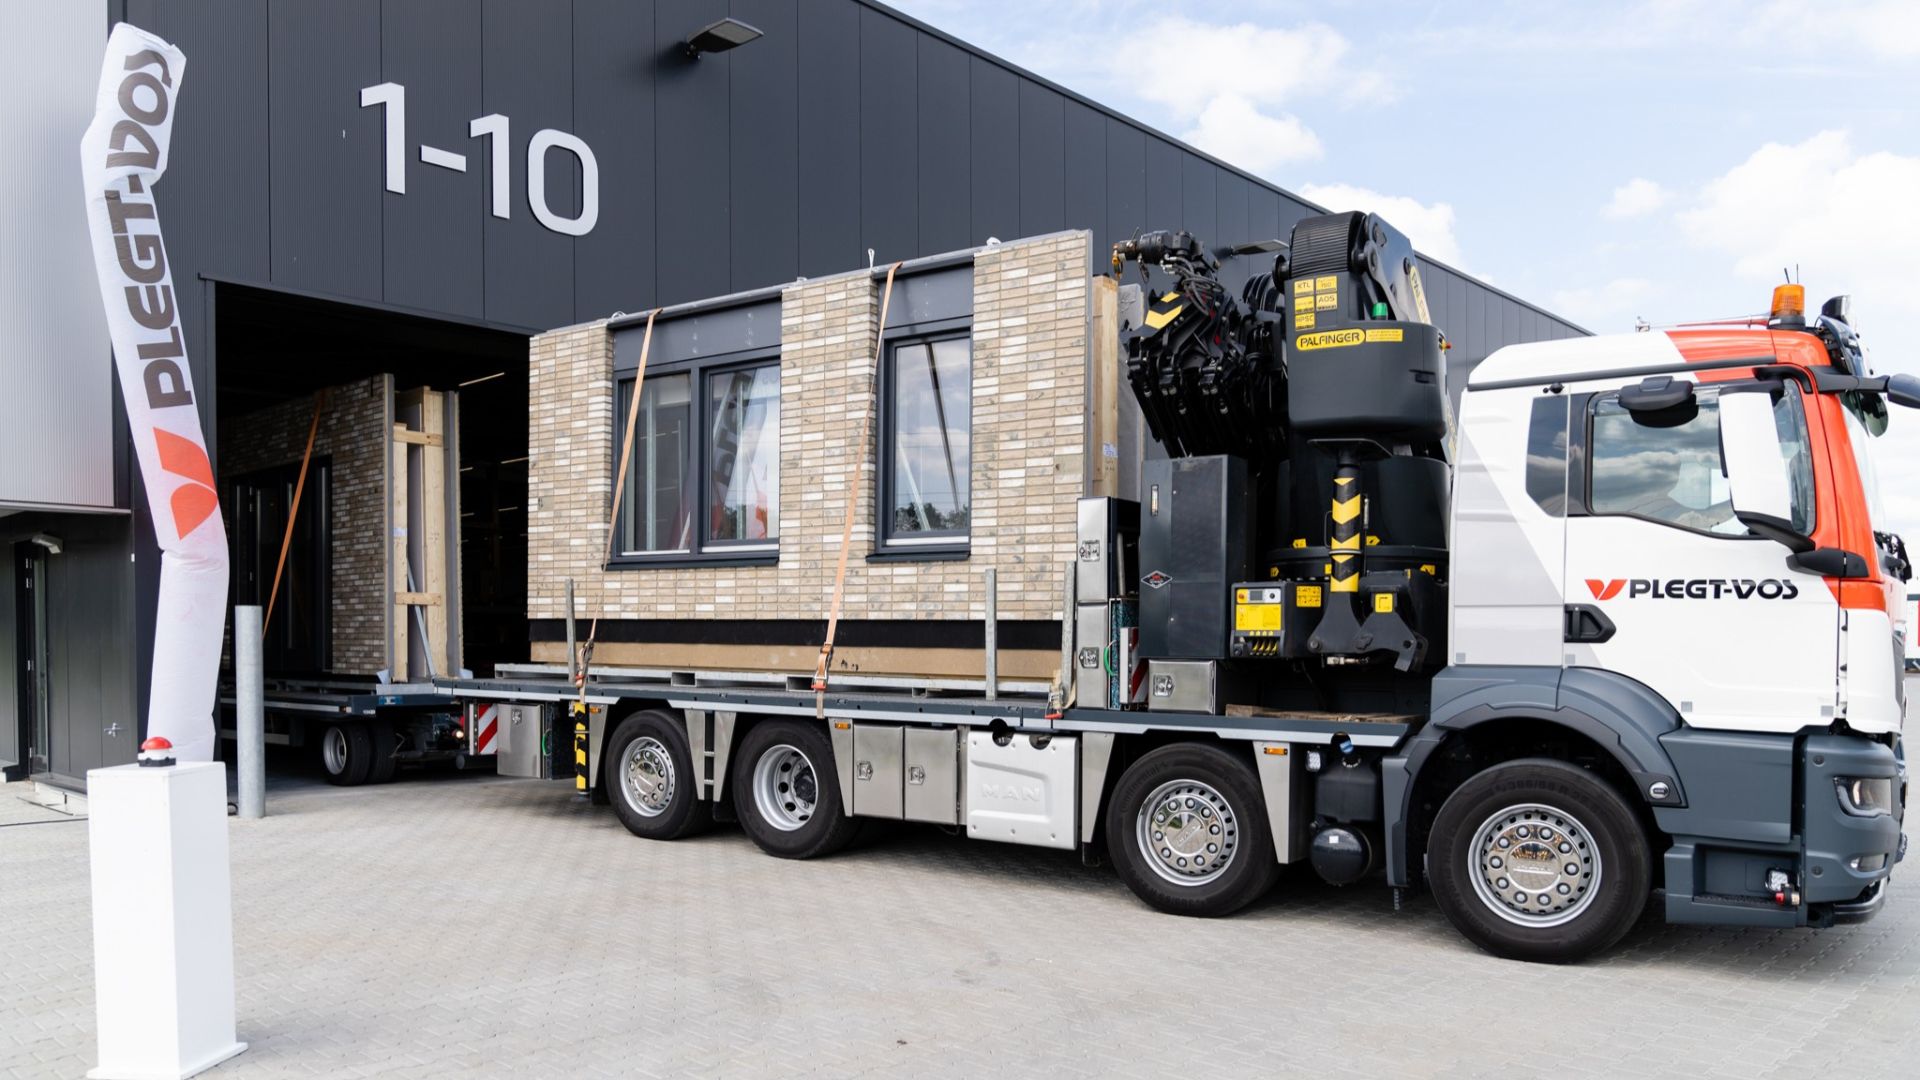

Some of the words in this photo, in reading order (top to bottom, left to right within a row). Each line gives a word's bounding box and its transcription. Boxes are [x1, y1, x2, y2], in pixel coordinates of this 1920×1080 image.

[360, 81, 599, 236] 1-10
[105, 49, 194, 410] PLEGT-VOS
[1300, 332, 1360, 348] PALFINGER
[1629, 579, 1799, 600] PLEGT-VOS
[981, 783, 1041, 802] MAN
